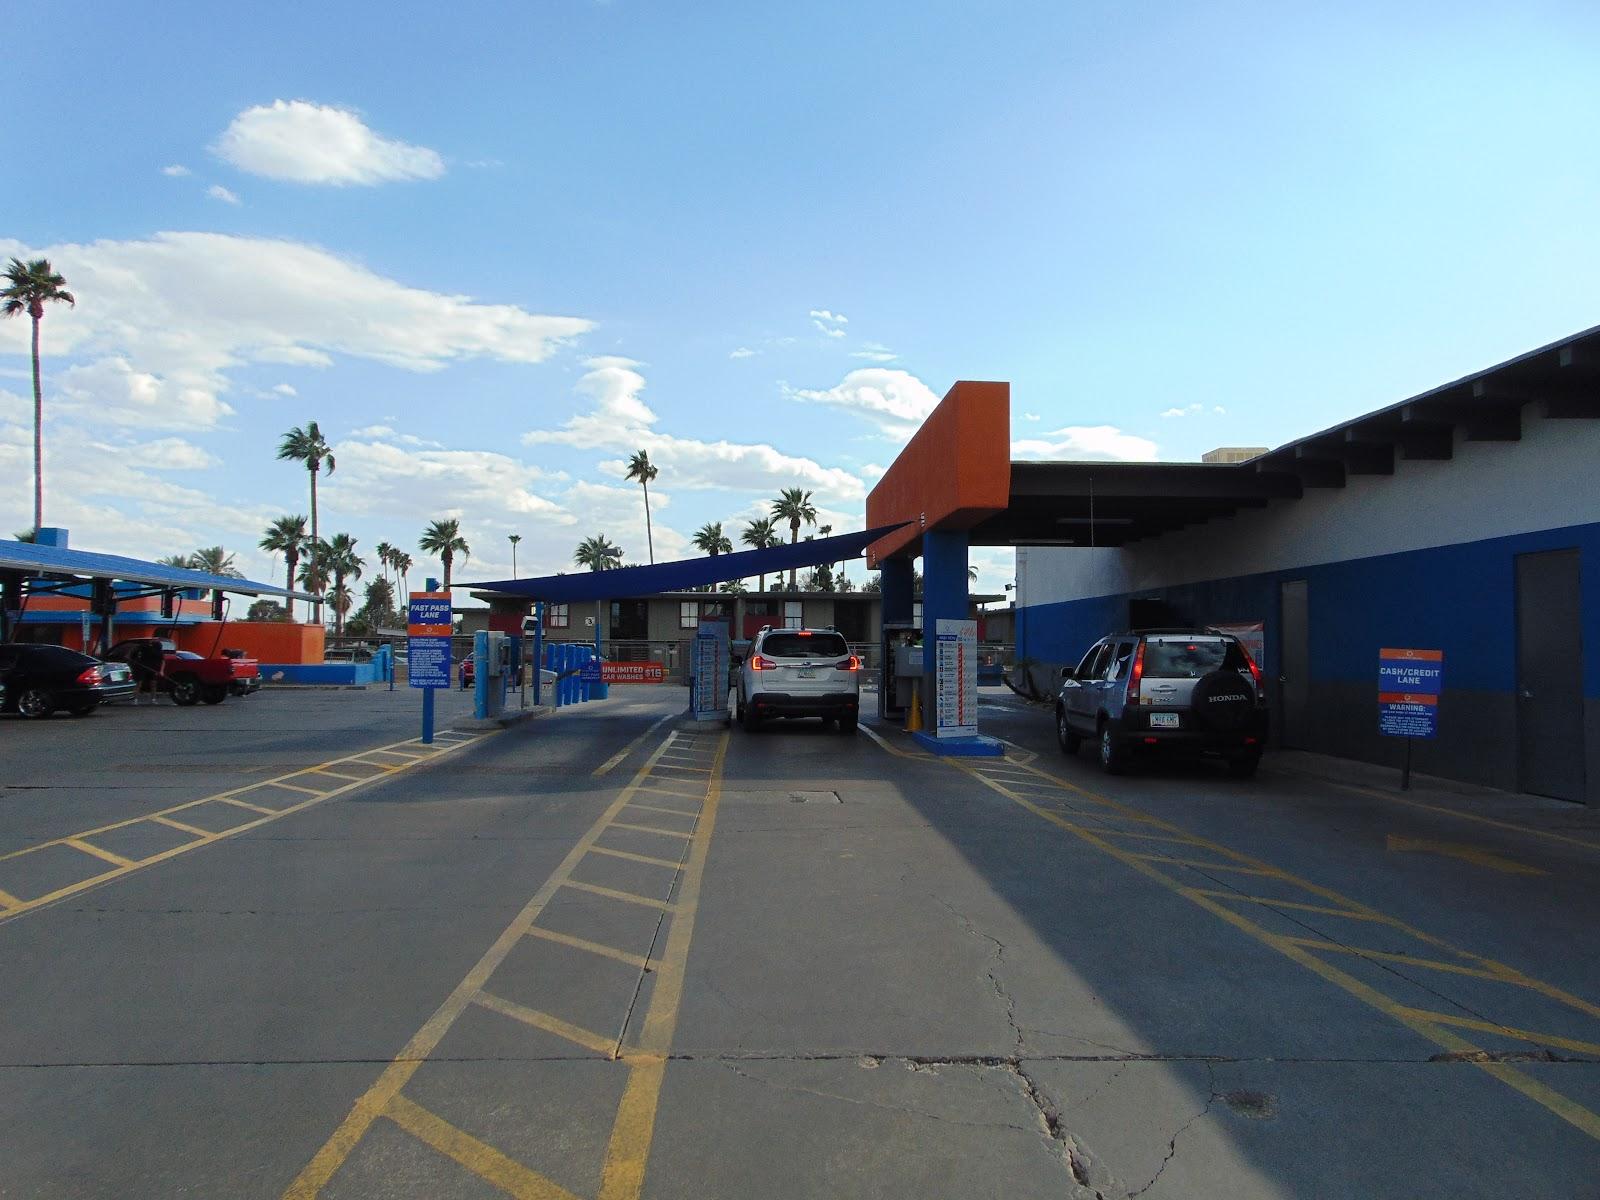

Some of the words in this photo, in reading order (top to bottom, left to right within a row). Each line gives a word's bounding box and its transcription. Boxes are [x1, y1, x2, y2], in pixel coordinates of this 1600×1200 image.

[1380, 667, 1440, 677] CASH/CREDIT
[1397, 676, 1421, 684] LANE
[1208, 694, 1248, 703] HONDA
[1389, 703, 1426, 712] WARNING:
